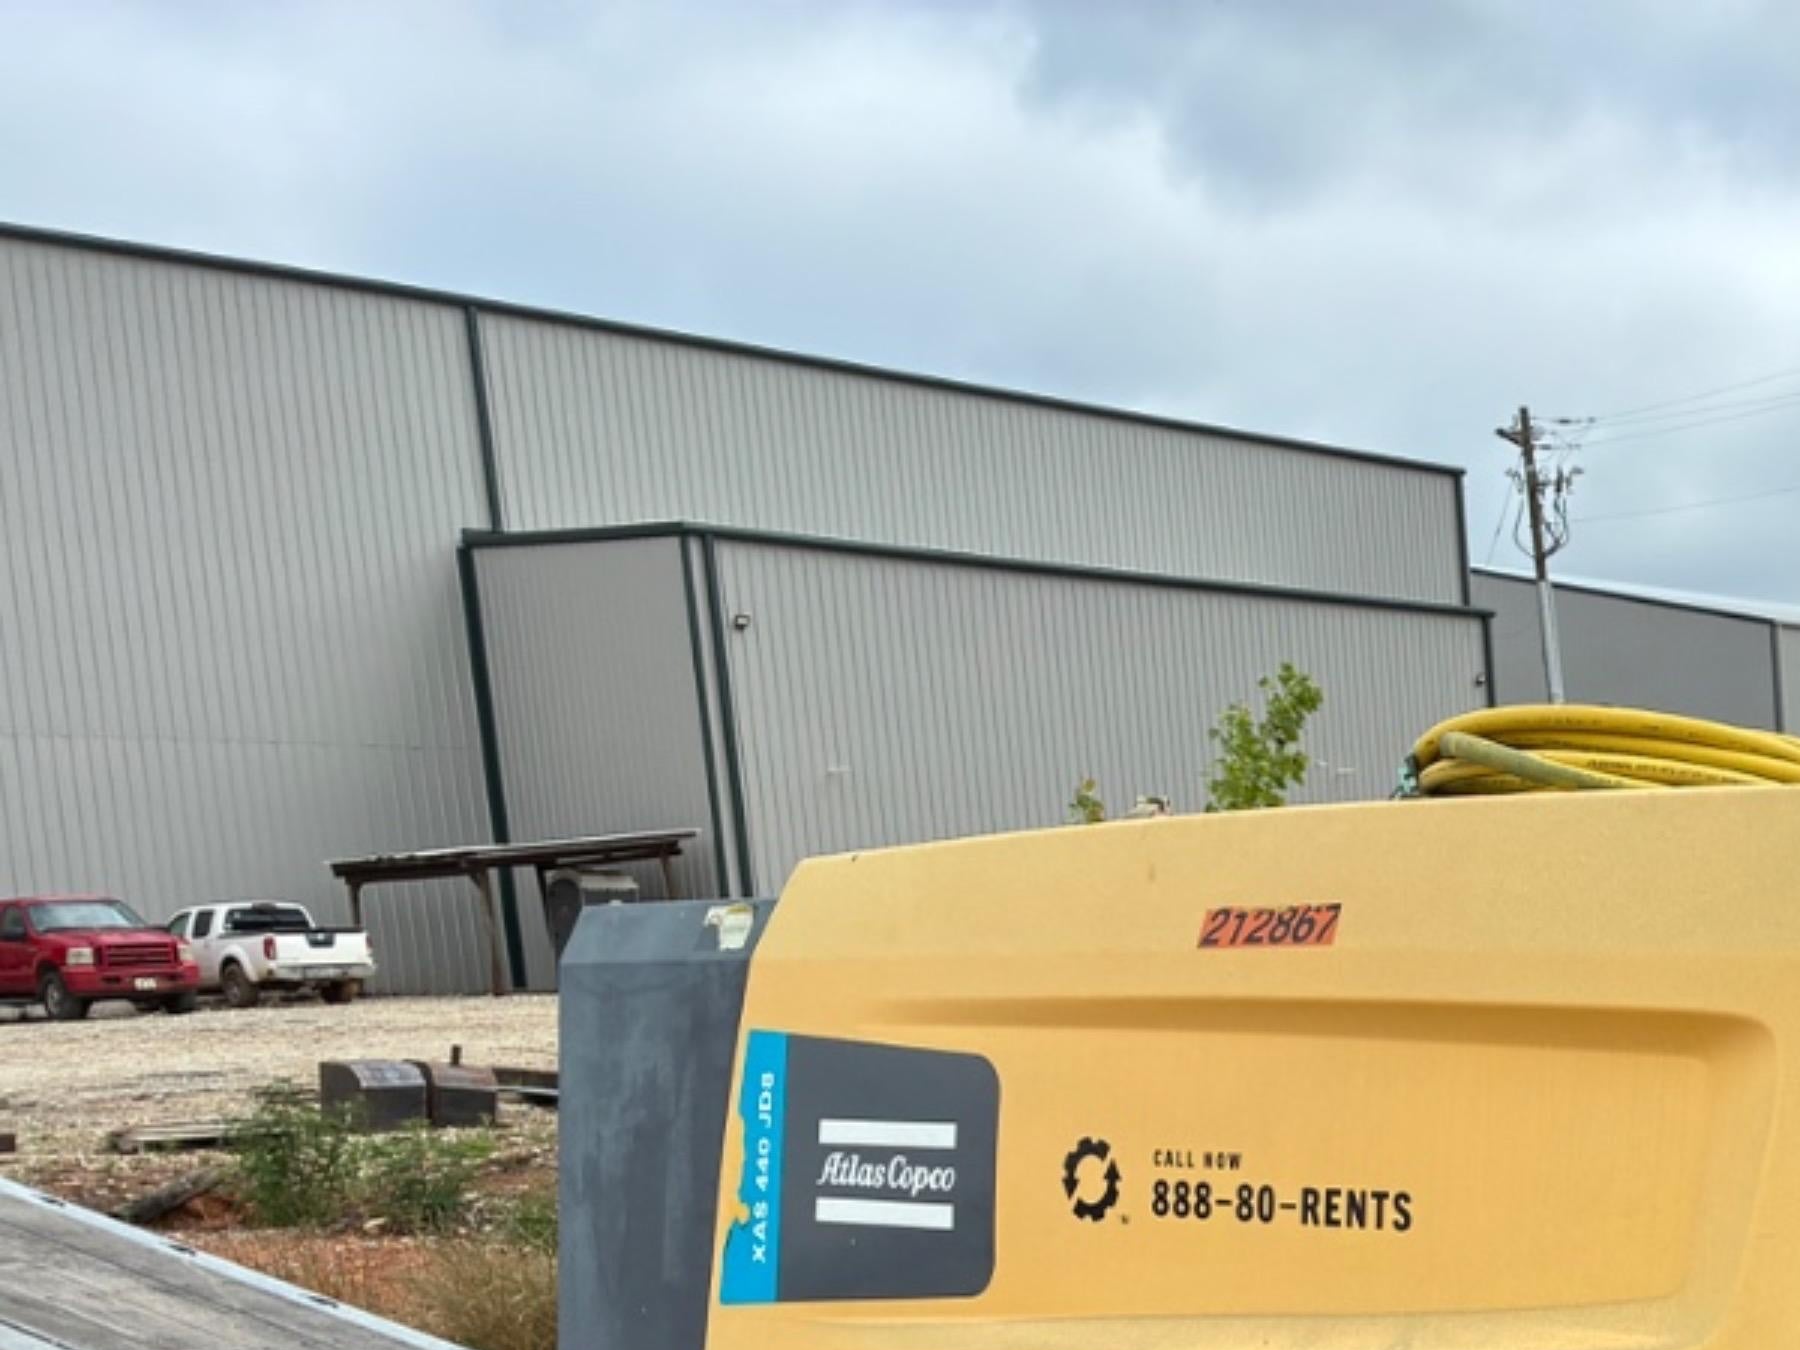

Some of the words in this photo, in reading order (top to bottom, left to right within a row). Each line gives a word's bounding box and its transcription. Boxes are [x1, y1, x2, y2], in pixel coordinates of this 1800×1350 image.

[1200, 903, 1341, 946] 212867
[755, 1137, 770, 1191] 440
[1153, 1150, 1195, 1168] CALL
[1203, 1152, 1242, 1170] NOW
[752, 1201, 768, 1263] XAS
[1152, 1179, 1412, 1232] 888-80-RENTS
